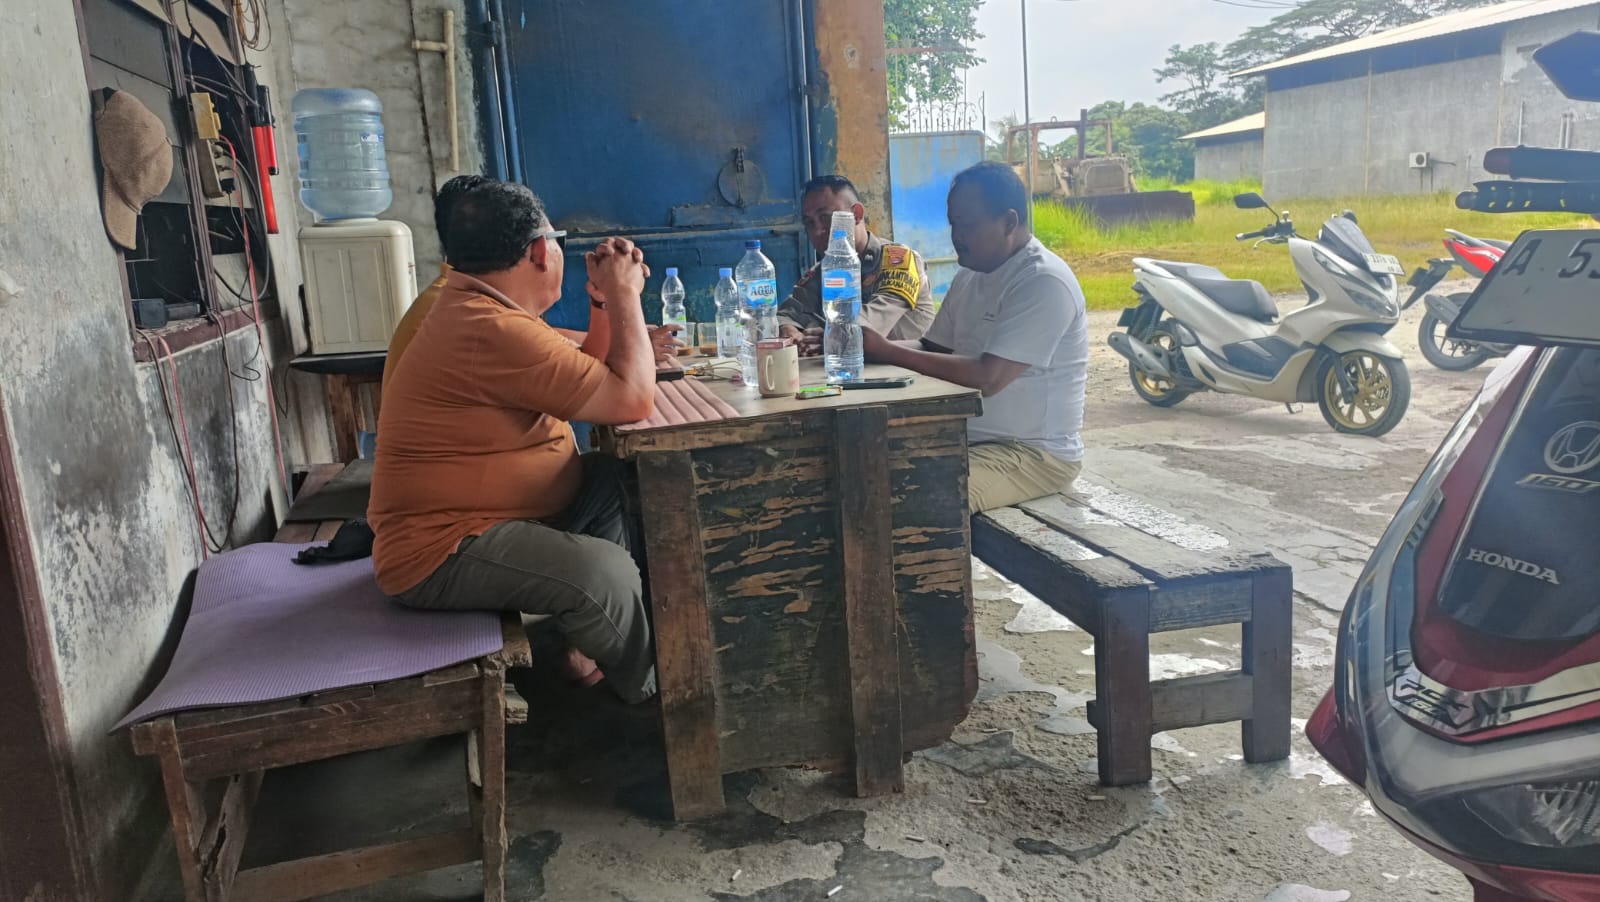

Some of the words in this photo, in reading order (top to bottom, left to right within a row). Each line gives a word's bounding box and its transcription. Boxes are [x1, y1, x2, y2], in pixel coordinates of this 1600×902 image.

[1502, 238, 1542, 276] A
[1557, 237, 1600, 279] 5
[1465, 548, 1560, 585] HONDA
